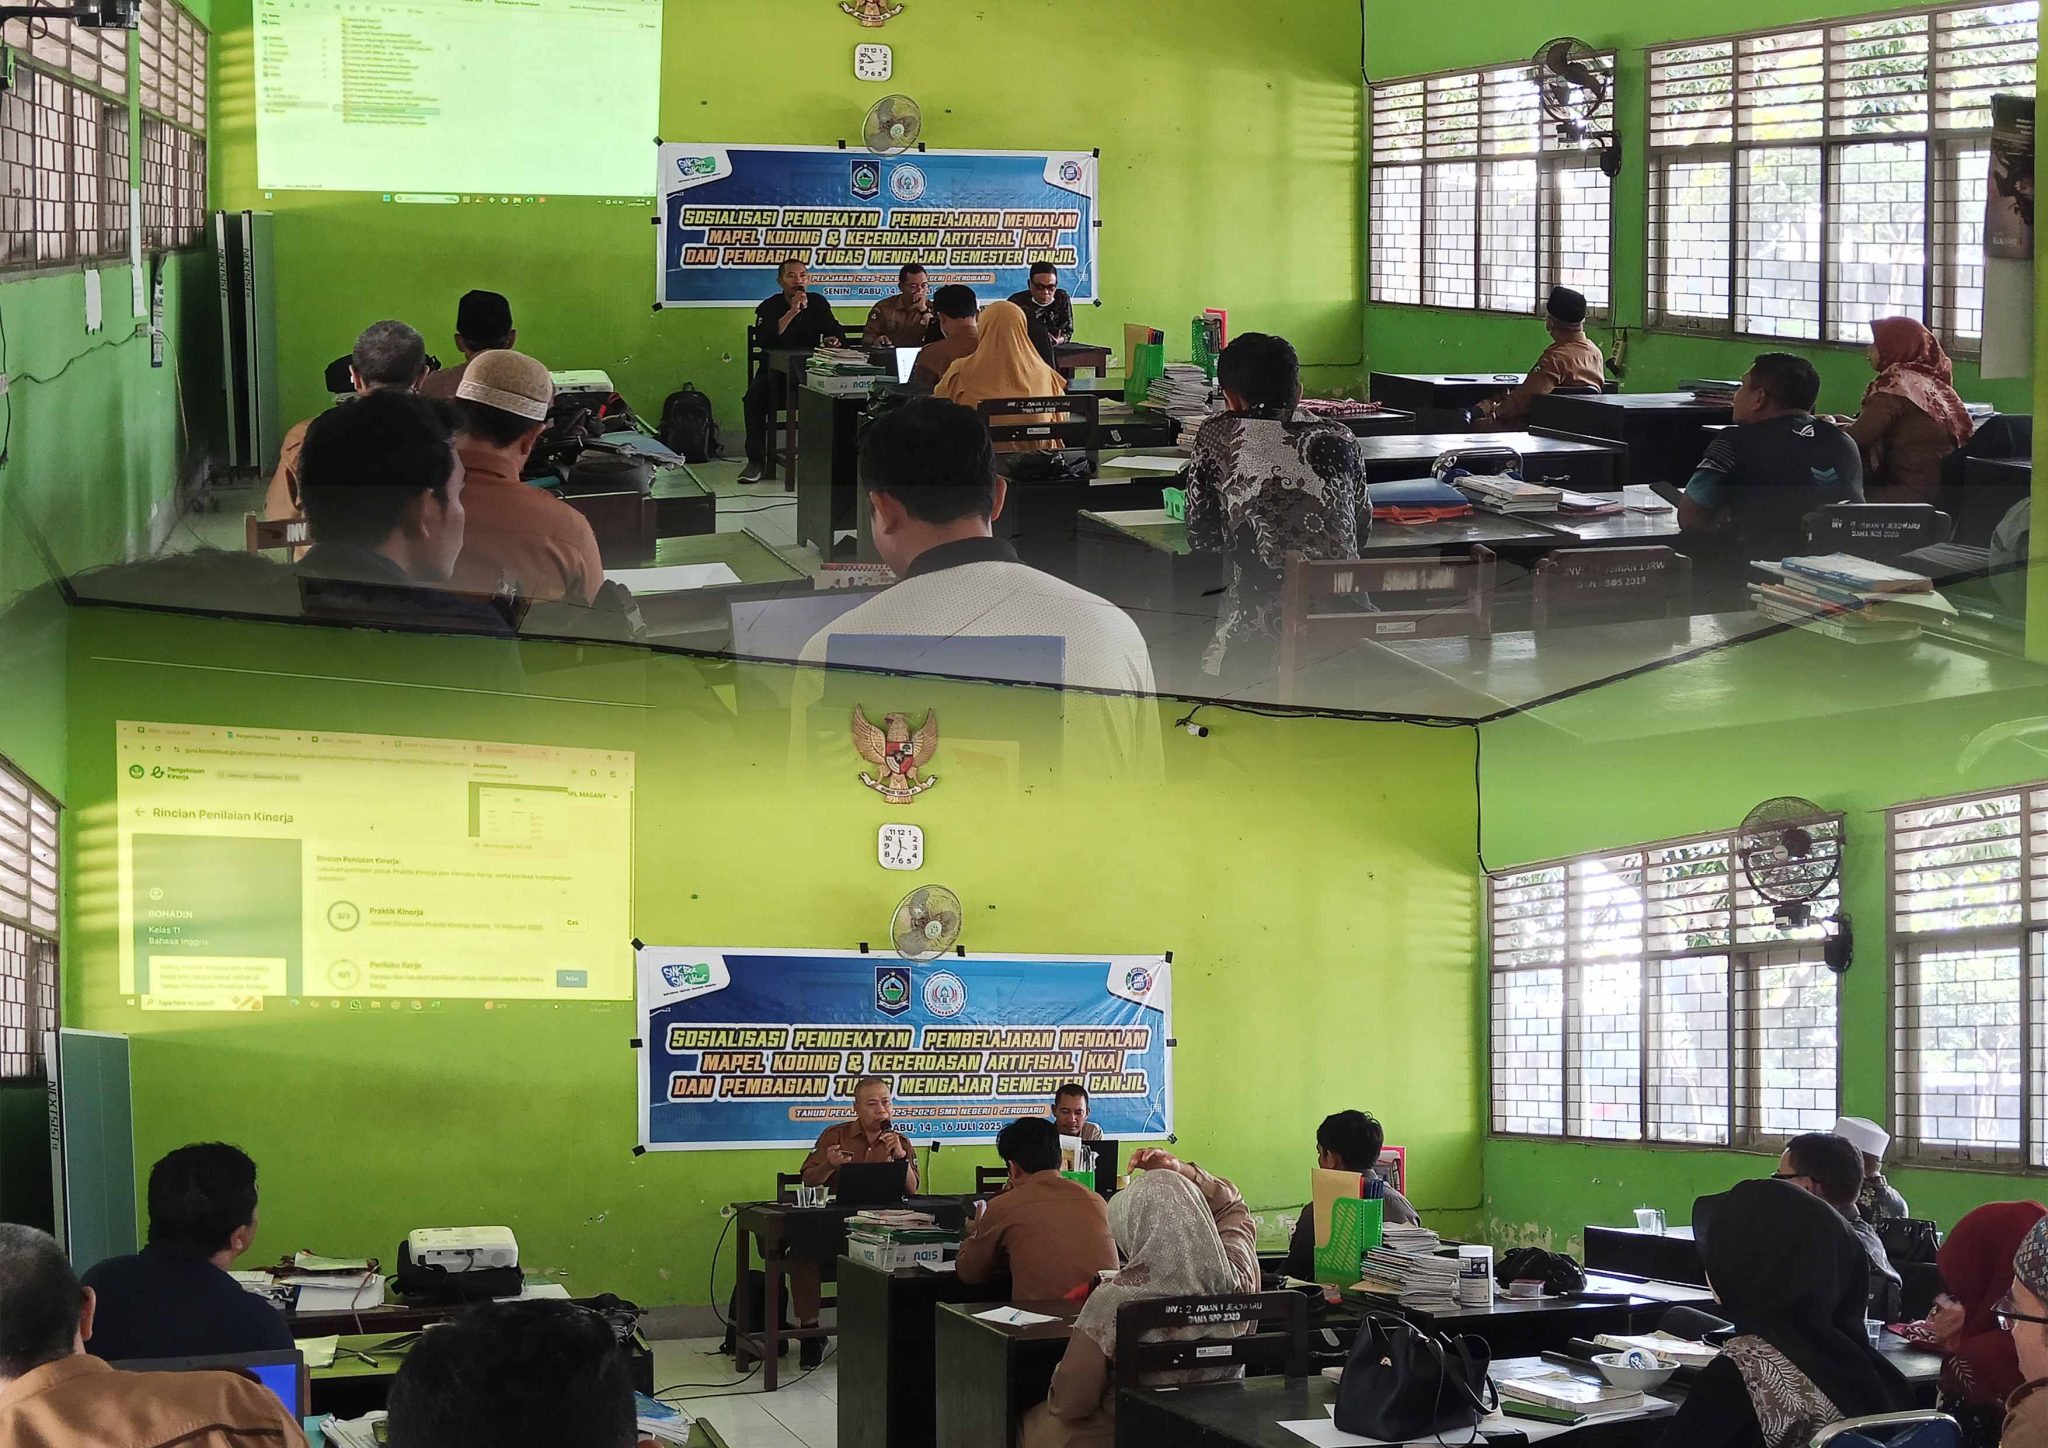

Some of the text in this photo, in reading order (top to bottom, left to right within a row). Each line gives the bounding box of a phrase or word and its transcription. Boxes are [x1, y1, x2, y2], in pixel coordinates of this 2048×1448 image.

[684, 210, 1077, 228] SOSIALISASI PENDEKATAN PEMBELAJARAN MENDALAM
[708, 229, 759, 244] MAPEL
[765, 230, 821, 245] KODING
[826, 231, 840, 246] &
[845, 230, 937, 247] KECERDASAN
[943, 231, 1015, 247] ARTIFISIAL
[685, 247, 1076, 265] DAN PEMBAGIAN TUGAS MENGAJAR SEMESTER GANJIL
[812, 274, 855, 282] PELAJARAN
[823, 287, 850, 295] SENIN
[858, 287, 883, 296] RABU,
[886, 287, 895, 295] 14
[153, 807, 294, 823] Rincian Penilaian Kinerja
[148, 910, 193, 919] ROHADIN
[369, 907, 424, 917] Praktik Kinerja
[148, 926, 171, 934] Kelas
[149, 937, 180, 945] Bahasa
[672, 1029, 1148, 1049] SOSIALISASI PENDEKATAN PEMBELAJARAN MENDALAM
[702, 1054, 764, 1071] MAPEL
[772, 1054, 840, 1071] KODING
[847, 1054, 863, 1072] &
[870, 1054, 982, 1071] KECERDASAN
[987, 1053, 1075, 1071] ARTIFISIAL
[673, 1077, 714, 1096] DAN
[721, 1077, 828, 1096] PEMBAGIAN
[900, 1076, 993, 1094] MENGAJAR
[1090, 1074, 1146, 1092] GANJIL
[796, 1109, 826, 1117] TAHUN
[938, 1107, 958, 1116] SMK
[960, 1107, 992, 1116] NEGERI
[1000, 1106, 1044, 1115] JEROWARU
[918, 1123, 931, 1132] 14
[942, 1123, 953, 1132] 16
[955, 1122, 976, 1132] JULI
[977, 1122, 1002, 1131] 2025
